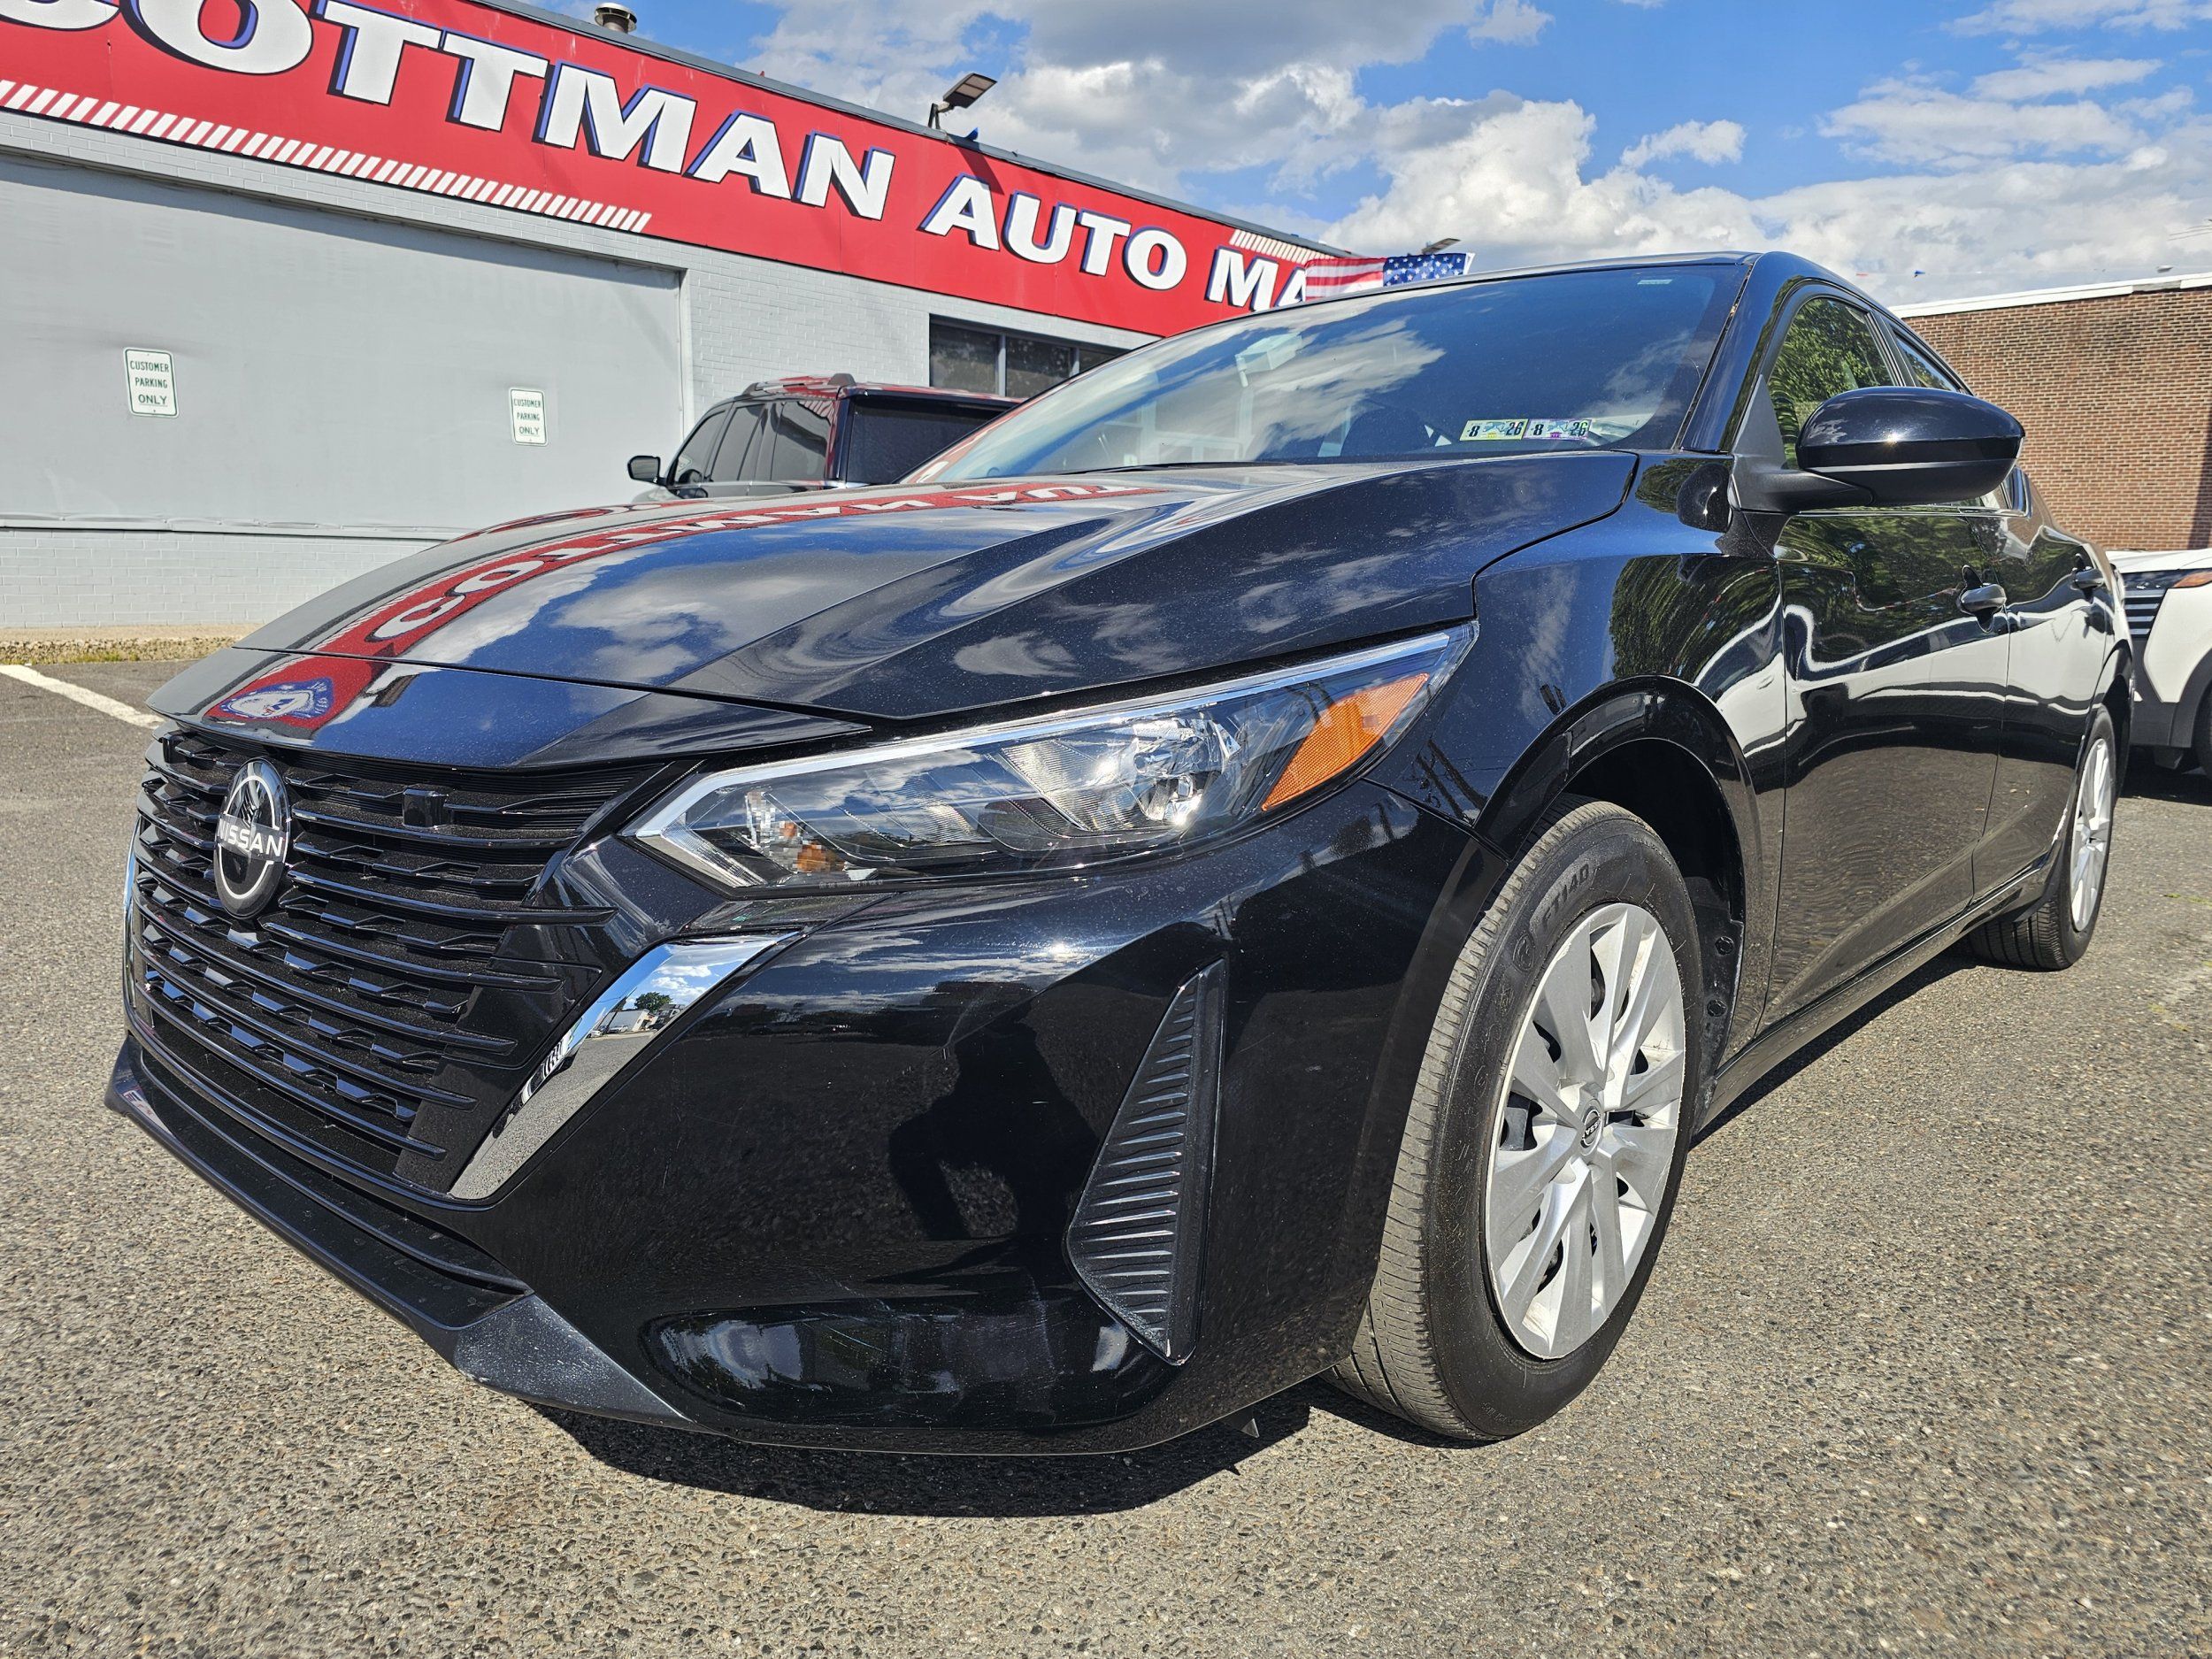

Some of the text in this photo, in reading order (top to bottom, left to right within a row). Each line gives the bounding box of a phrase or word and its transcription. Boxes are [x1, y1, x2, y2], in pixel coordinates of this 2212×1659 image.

[0, 0, 895, 220] OTTMAN
[919, 173, 1188, 291] AUTO
[129, 360, 169, 373] CUSTOMER
[134, 377, 168, 389] PARKING
[138, 394, 167, 405] ONLY
[513, 398, 541, 408] CUSTOMER
[517, 411, 541, 421] PARKING
[518, 426, 540, 434] ONLY
[1468, 421, 1525, 437] 8 26
[1532, 424, 1544, 436] 8
[217, 818, 283, 856] NISSAN
